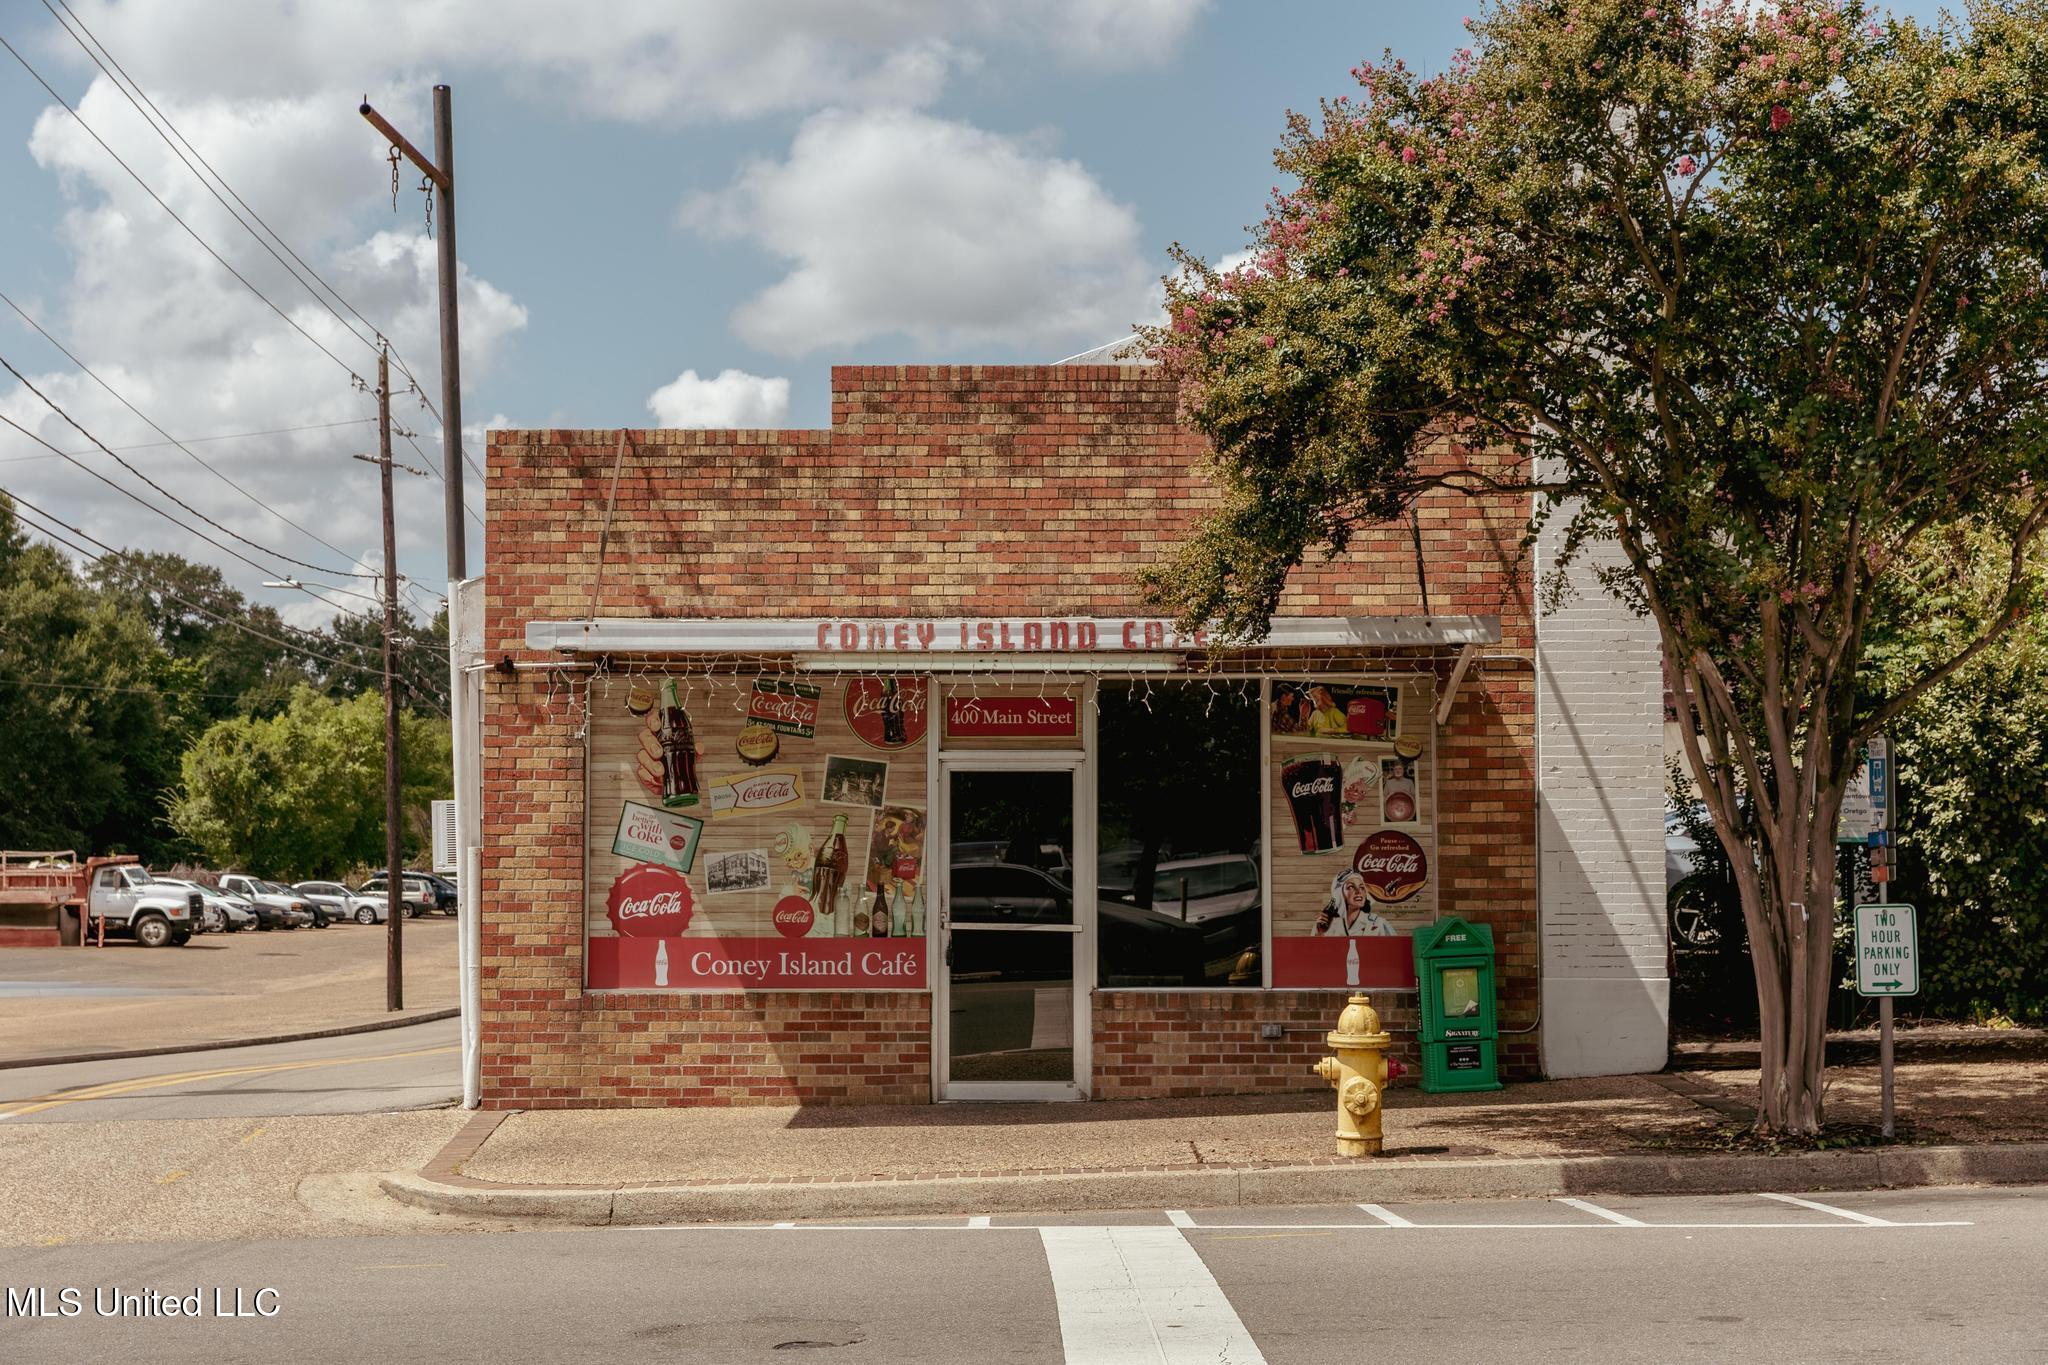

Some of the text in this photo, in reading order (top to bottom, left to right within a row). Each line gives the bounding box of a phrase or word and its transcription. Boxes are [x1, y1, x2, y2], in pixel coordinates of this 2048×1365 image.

[817, 622, 936, 650] CONEY
[960, 622, 1097, 650] ISLAND
[951, 709, 1073, 724] 400 Main Street
[627, 825, 663, 845] Coke
[640, 822, 662, 835] with
[1874, 913, 1896, 927] TWO
[1445, 934, 1467, 942] FREE
[1871, 930, 1901, 943] HOUR
[1864, 946, 1910, 959] PARKING
[691, 951, 917, 981] Coney Island Café
[1874, 963, 1900, 976] ONLY
